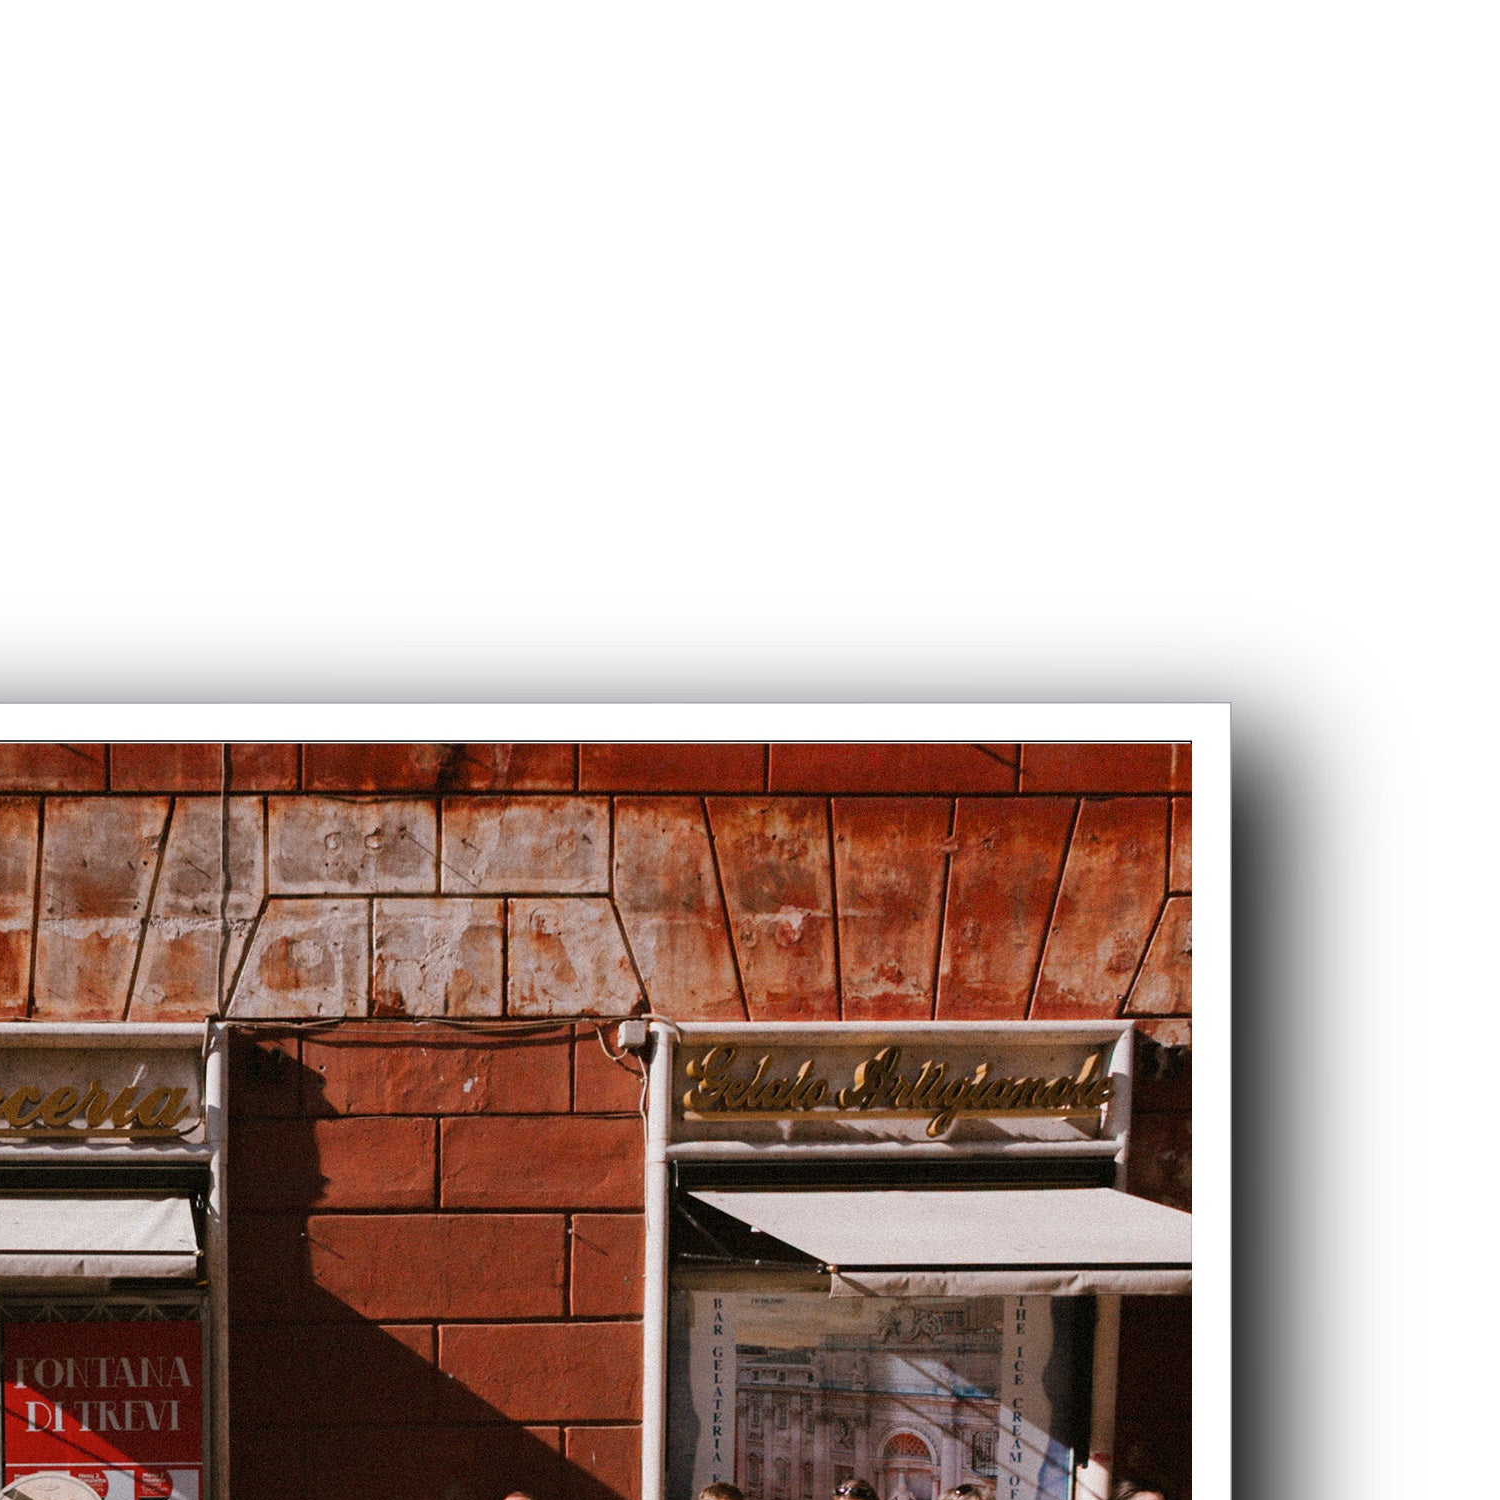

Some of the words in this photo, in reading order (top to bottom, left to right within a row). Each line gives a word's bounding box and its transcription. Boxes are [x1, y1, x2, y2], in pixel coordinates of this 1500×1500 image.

[683, 1042, 829, 1109] Gelato
[836, 1046, 1114, 1138] Artigianale
[713, 1298, 723, 1336] BAR
[1016, 1296, 1027, 1335] THE
[13, 1356, 194, 1389] FONTANA
[1013, 1346, 1025, 1386] ICE
[25, 1401, 66, 1433] DI
[74, 1400, 181, 1433] TREVI
[712, 1346, 723, 1463] GELATERIA
[1009, 1398, 1024, 1464] CREAM
[1009, 1475, 1021, 1500] OF
